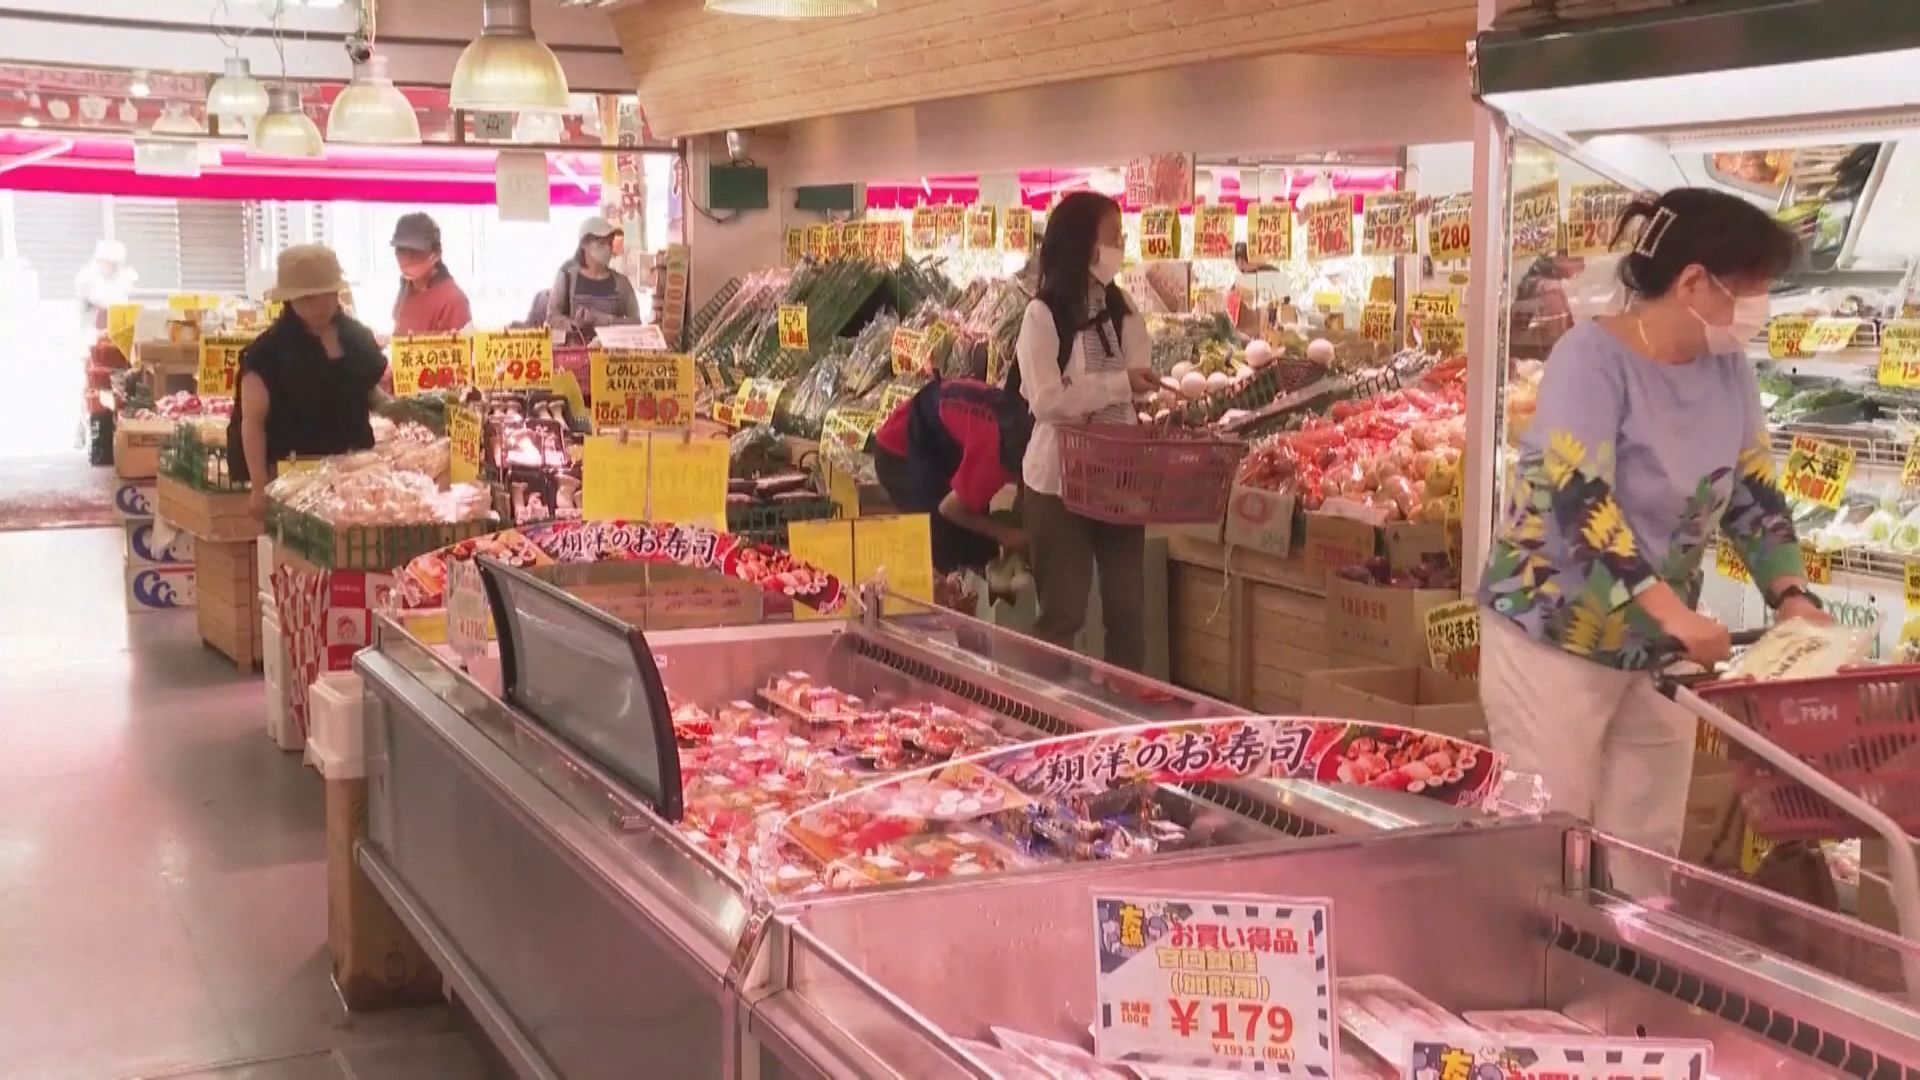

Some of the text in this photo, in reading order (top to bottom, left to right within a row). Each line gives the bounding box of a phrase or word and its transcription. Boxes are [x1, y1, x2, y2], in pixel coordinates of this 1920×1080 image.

[1375, 225, 1404, 250] 198
[1440, 223, 1470, 251] 280
[559, 526, 718, 564] 翔洋のお寿司
[1046, 726, 1313, 784] 翔洋のお寿司
